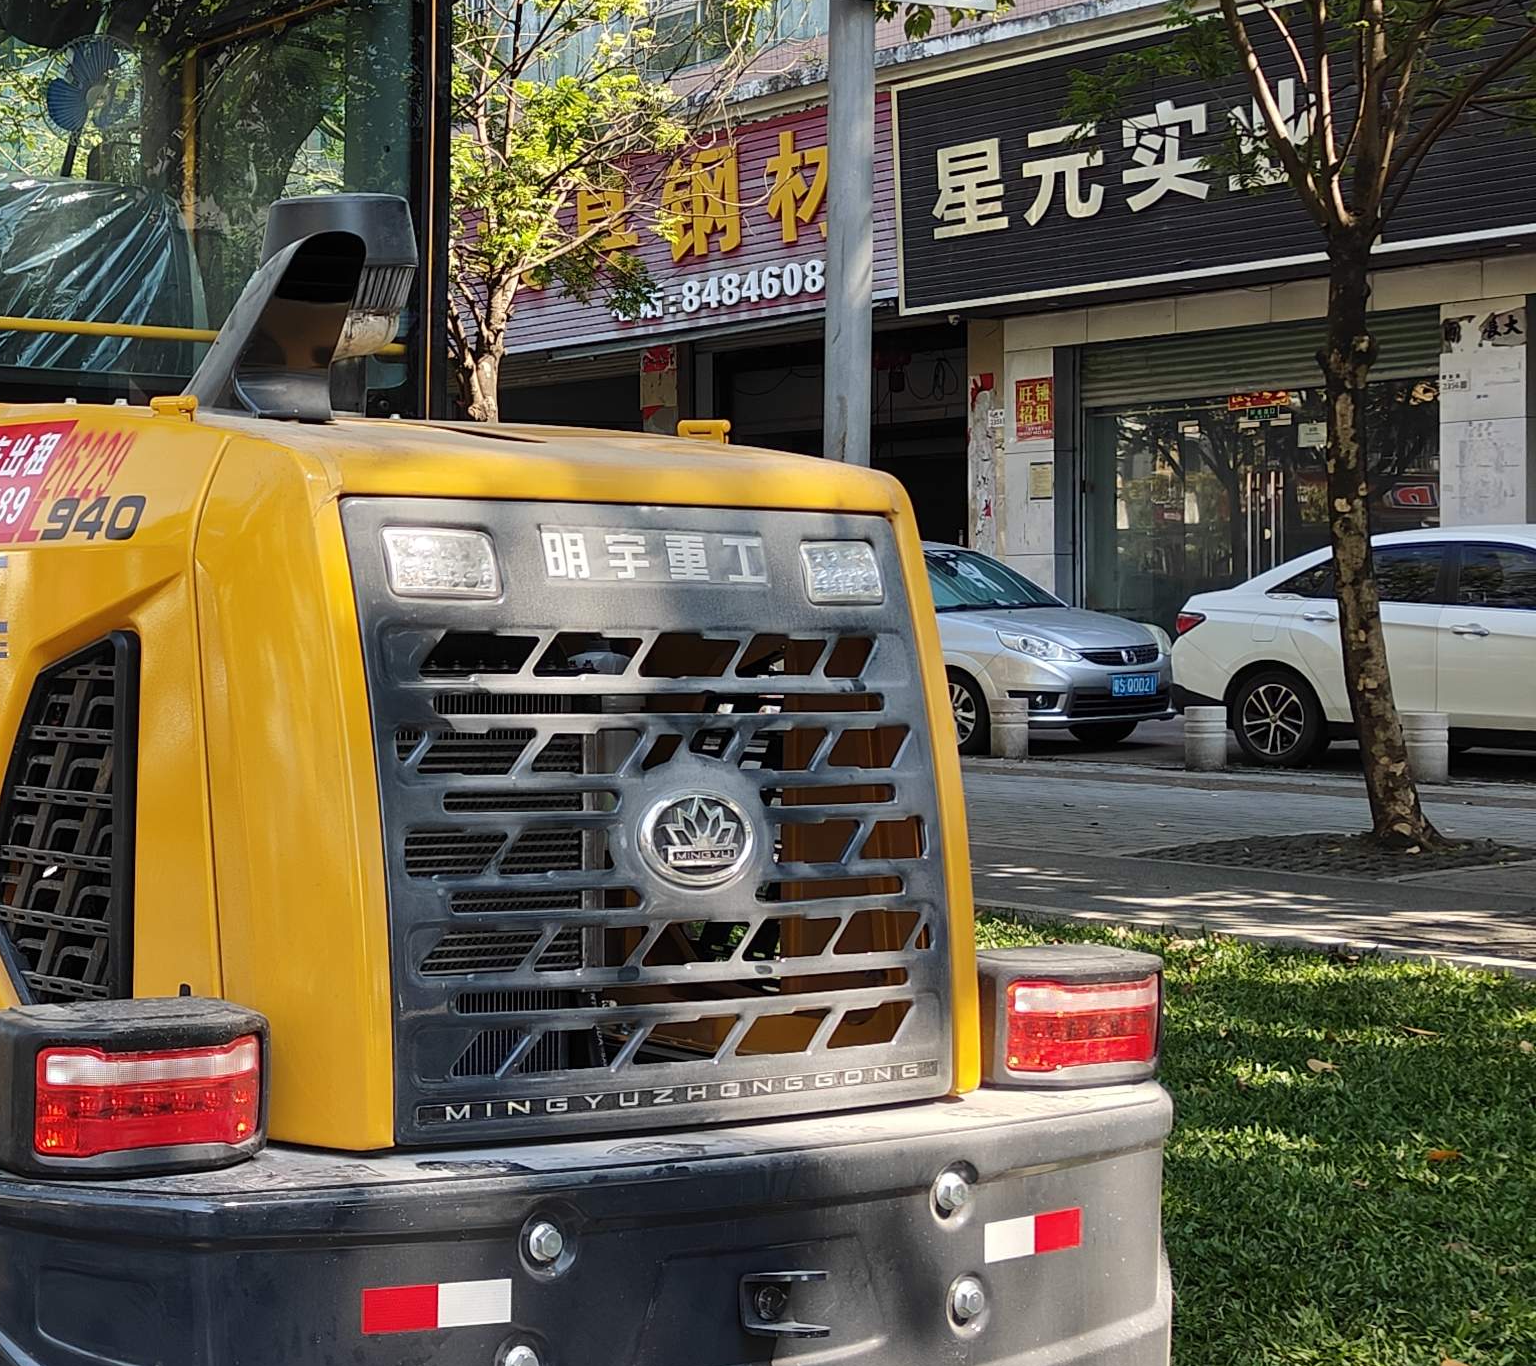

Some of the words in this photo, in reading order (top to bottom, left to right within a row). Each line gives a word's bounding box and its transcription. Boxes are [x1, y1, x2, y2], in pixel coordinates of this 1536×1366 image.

[541, 532, 768, 583] 明宇重工
[675, 849, 732, 861] MINGYU
[444, 1063, 920, 1122] MINGYUZHONGGONG
